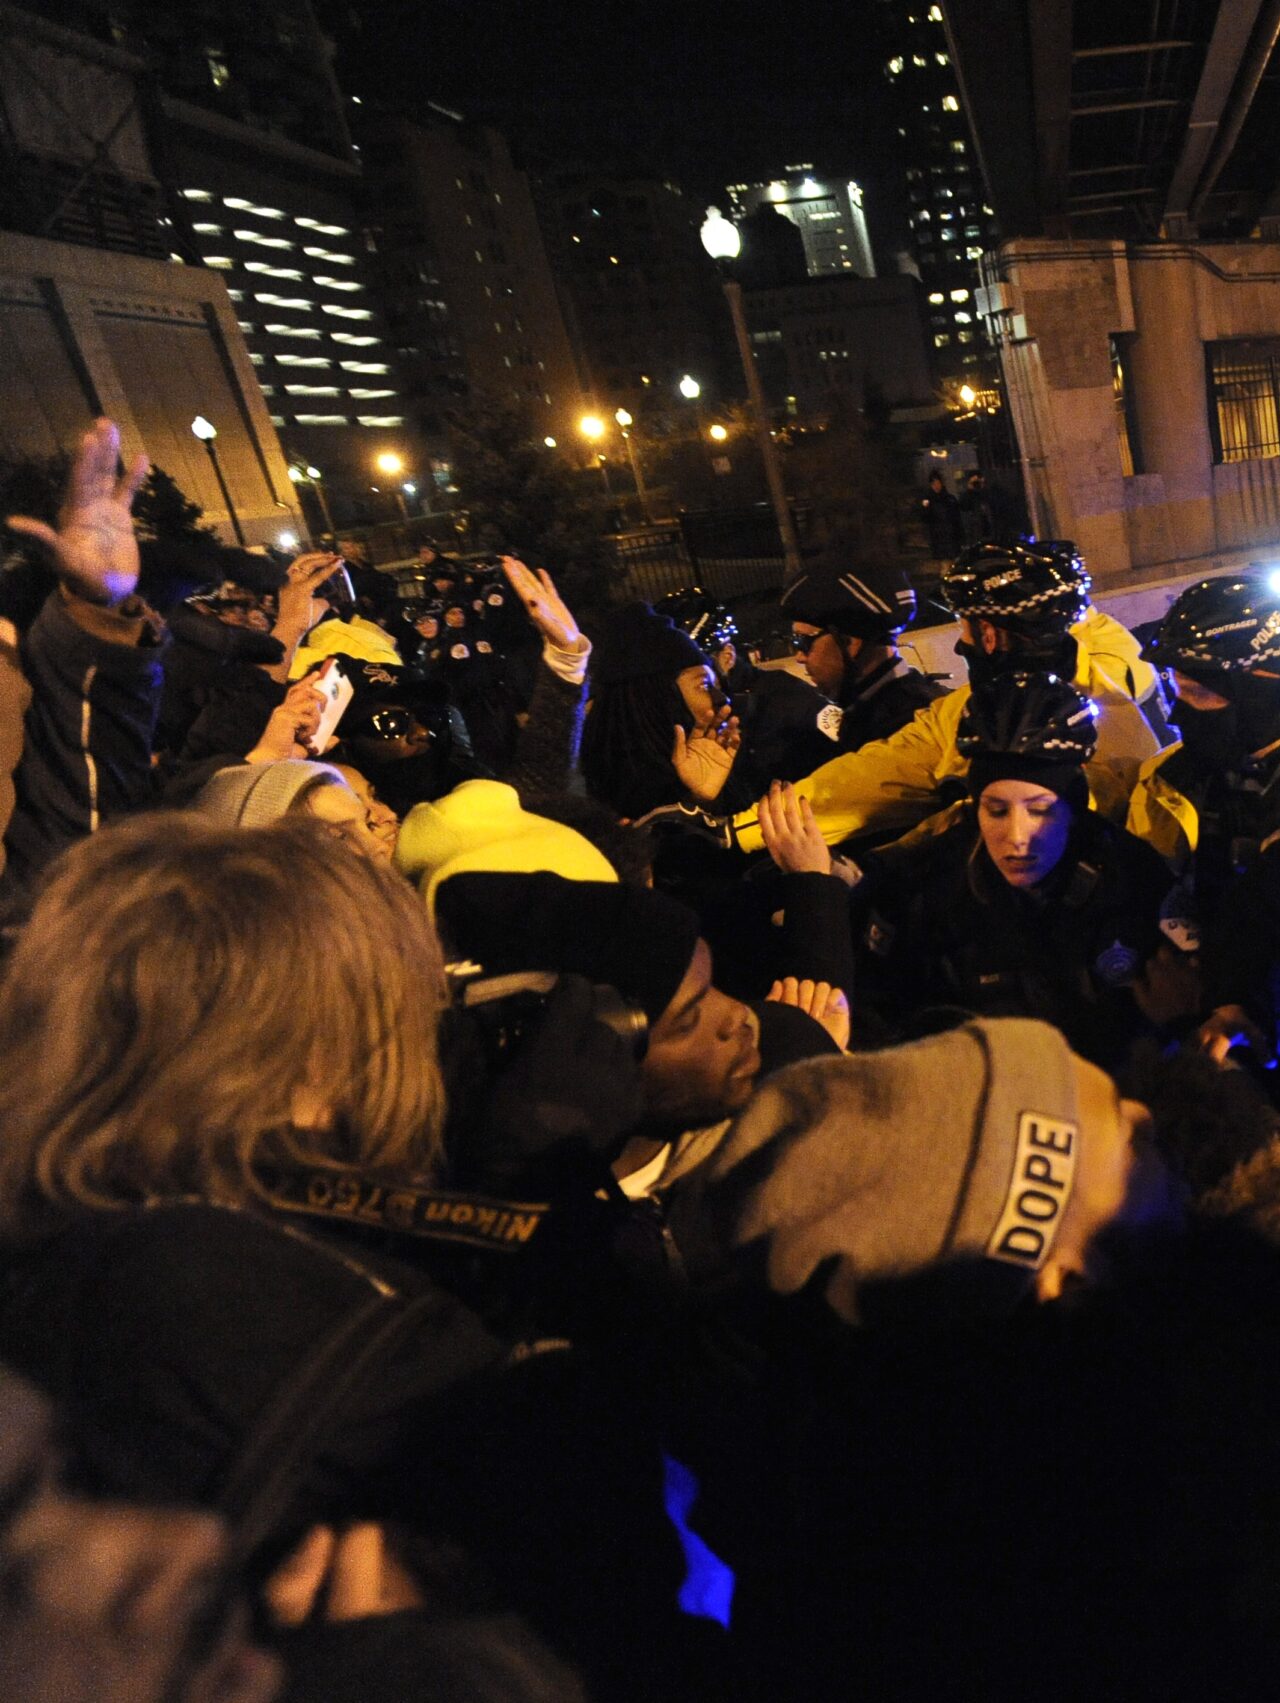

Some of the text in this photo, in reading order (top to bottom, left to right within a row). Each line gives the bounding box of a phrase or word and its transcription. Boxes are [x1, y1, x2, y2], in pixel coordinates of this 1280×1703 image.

[983, 568, 1022, 591] POLICE
[1205, 618, 1258, 637] BONTRAGER
[998, 1122, 1074, 1261] DOPE
[424, 1200, 542, 1242] Nikon
